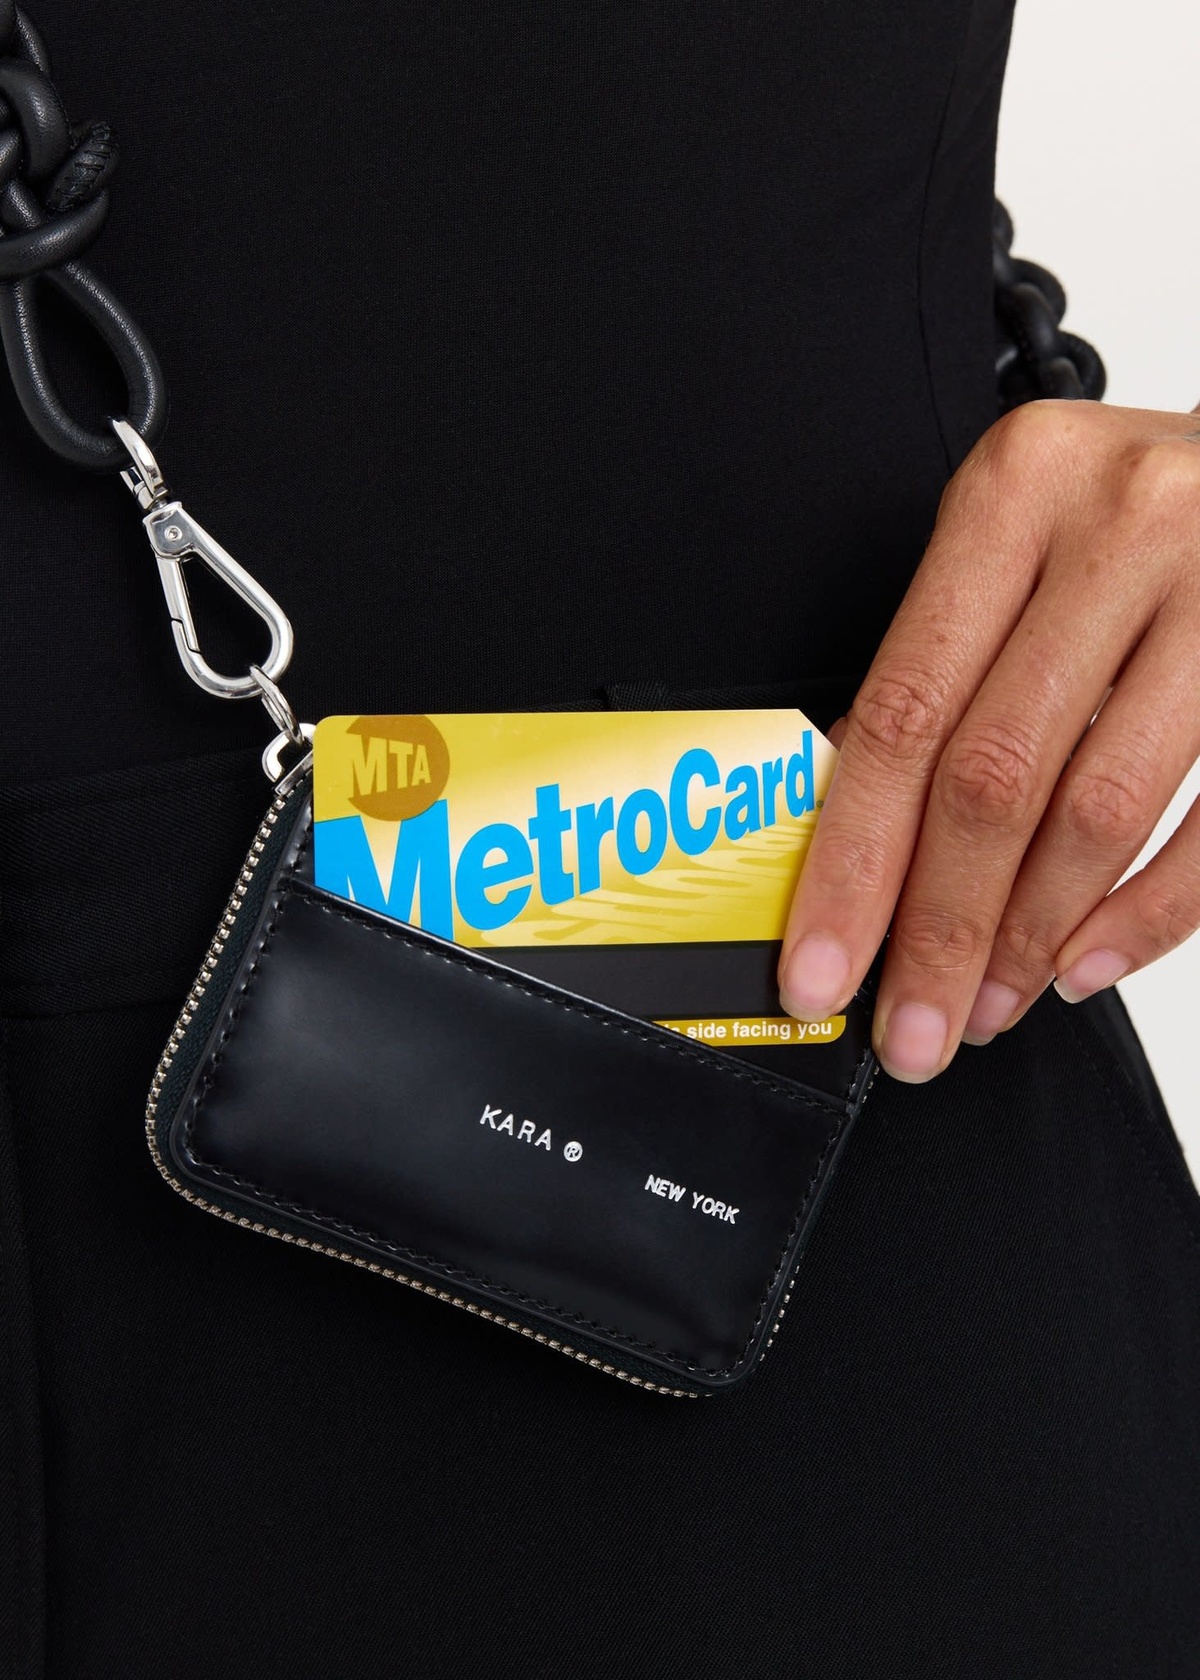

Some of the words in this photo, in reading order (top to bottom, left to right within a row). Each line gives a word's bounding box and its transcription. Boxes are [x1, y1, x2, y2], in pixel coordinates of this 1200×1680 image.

[348, 735, 431, 796] MTA
[687, 1022, 727, 1039] side
[732, 1021, 791, 1040] facing
[797, 1022, 832, 1040] you
[480, 1104, 551, 1151] KARA
[644, 1174, 686, 1202] NEW
[692, 1191, 740, 1225] YORK
